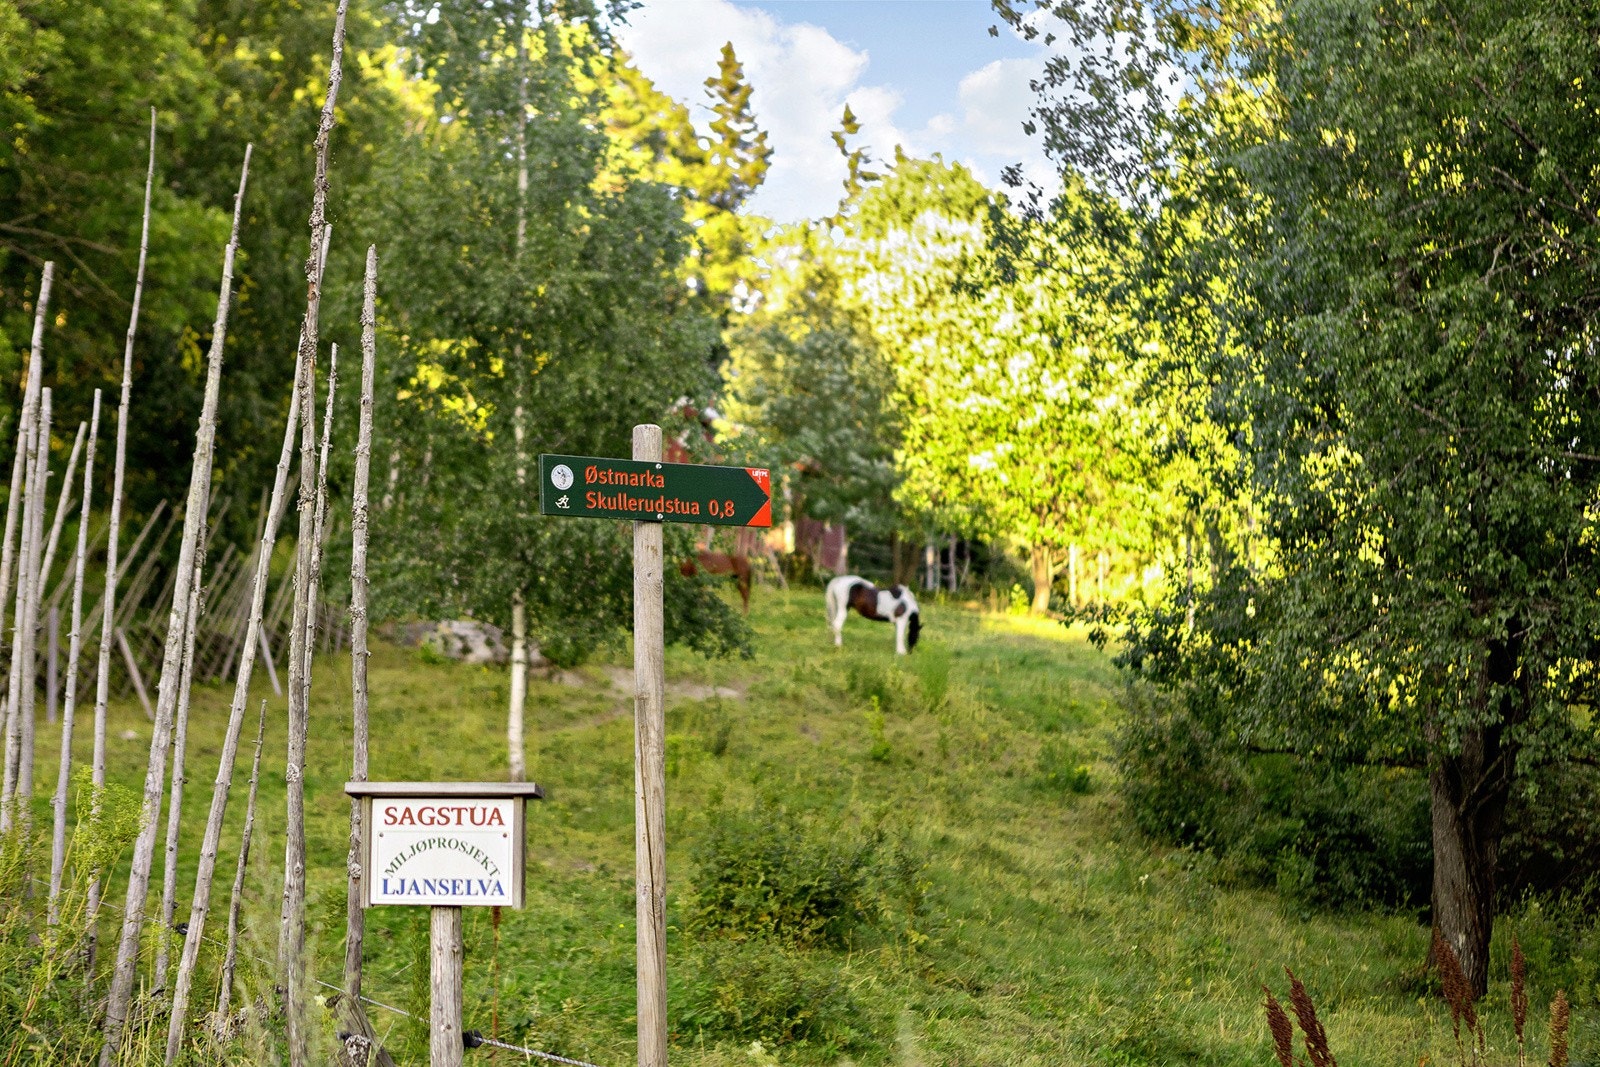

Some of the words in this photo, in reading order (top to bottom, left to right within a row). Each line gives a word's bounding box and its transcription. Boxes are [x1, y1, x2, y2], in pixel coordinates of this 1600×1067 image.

[584, 466, 665, 488] Østmarka
[585, 491, 700, 515] Skullerudstua
[708, 499, 735, 518] 0,8
[384, 807, 505, 826] SAGSTUA
[384, 837, 500, 878] MILJØPROSJEKT
[382, 878, 505, 896] LJANSELVA
